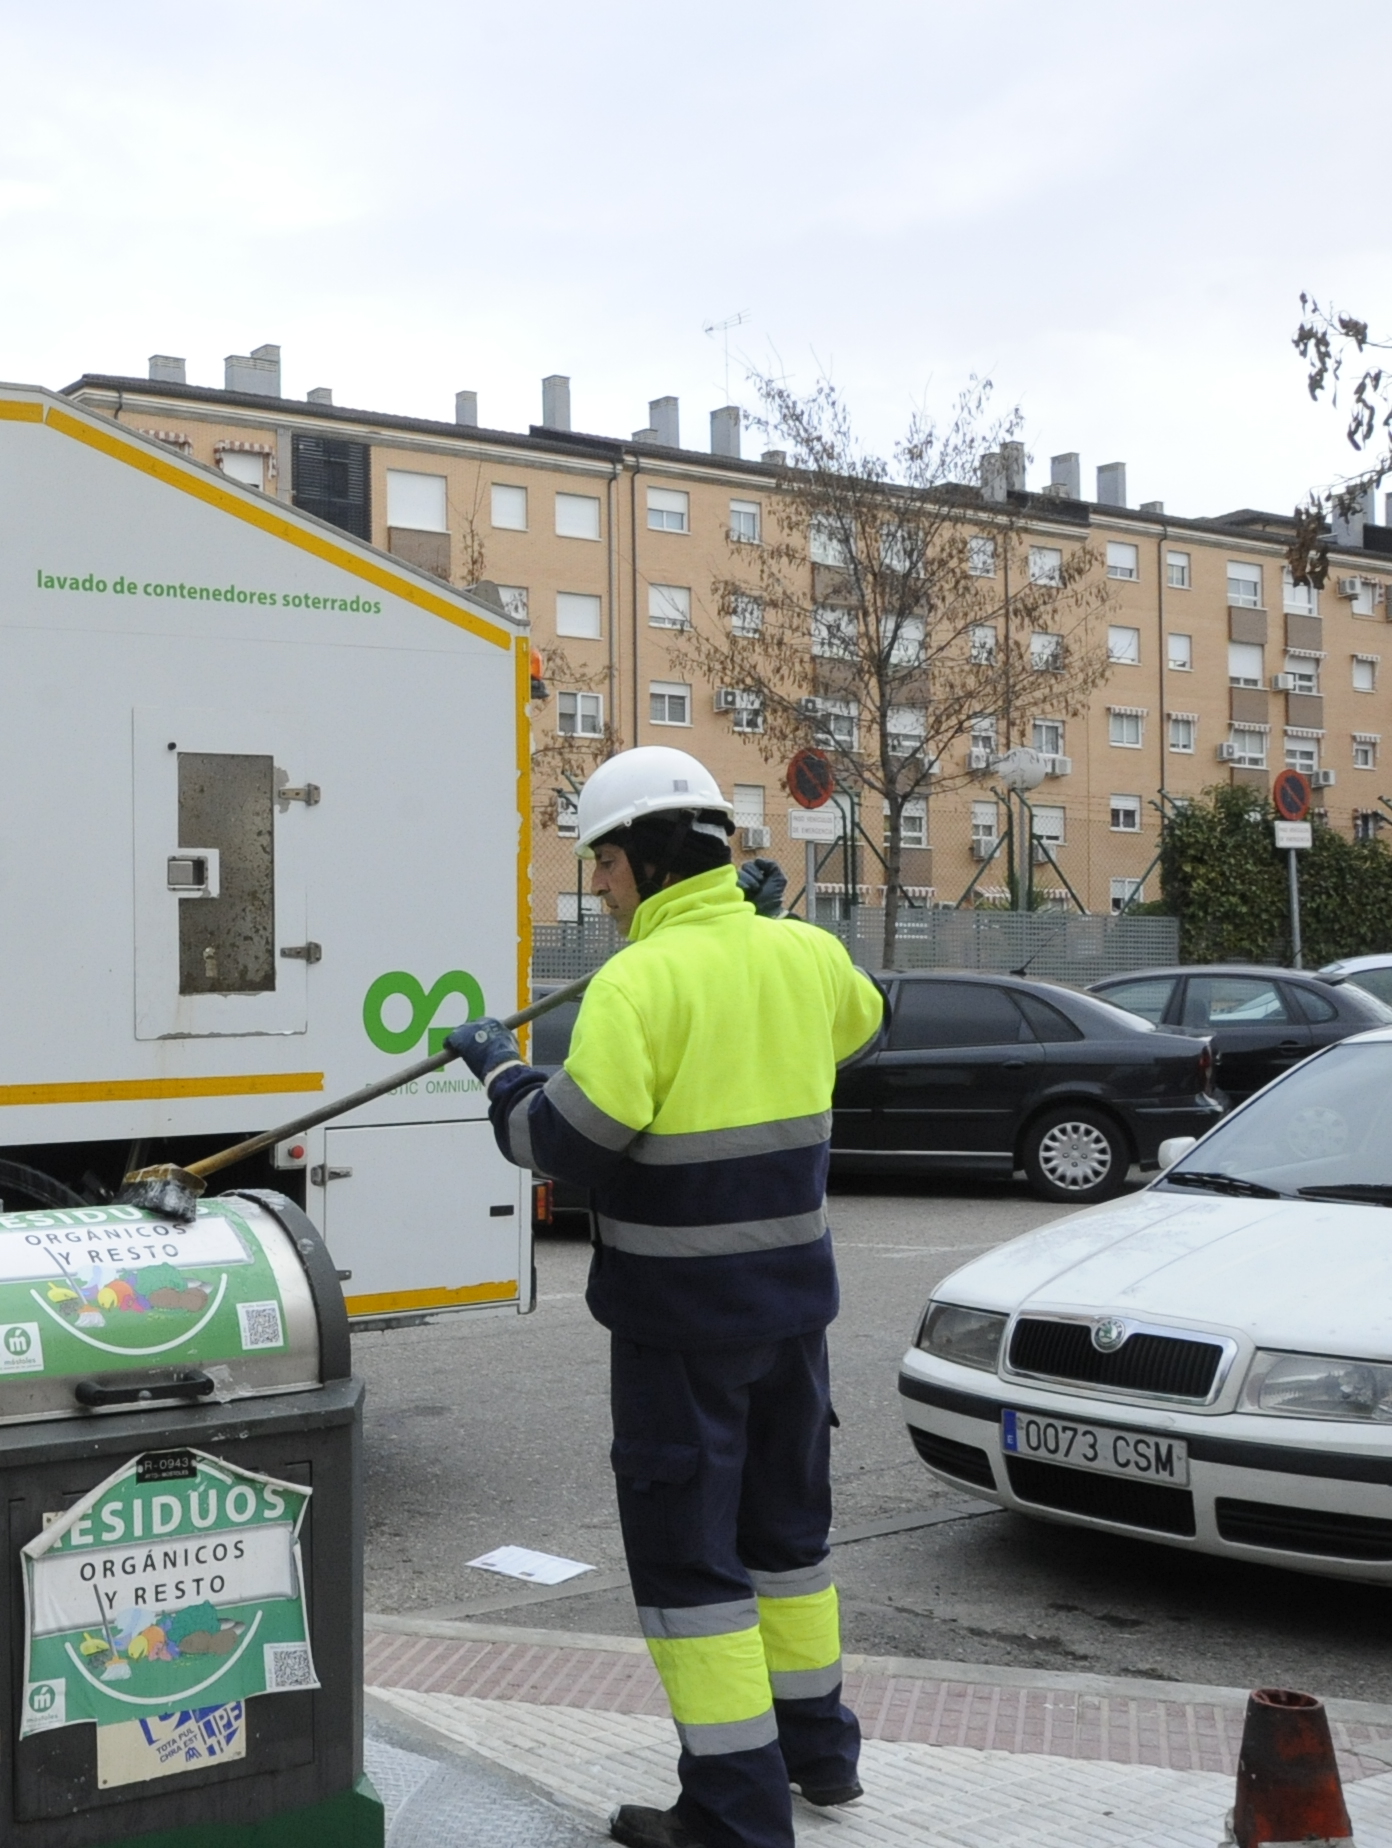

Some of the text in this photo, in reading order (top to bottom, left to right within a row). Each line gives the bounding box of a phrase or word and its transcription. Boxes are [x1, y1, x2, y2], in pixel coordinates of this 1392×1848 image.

[37, 569, 382, 614] lavado de contenedores soterrados
[425, 1079, 482, 1095] OMNIUM
[24, 1223, 188, 1246] ORGÁNICOS
[57, 1243, 180, 1266] Y RESTO
[1025, 1420, 1098, 1462] 0073
[1112, 1435, 1174, 1477] CSM
[80, 1540, 244, 1582] ORGÁNICOS
[104, 1575, 225, 1610] Y RESTO
[156, 1738, 177, 1755] TOTA
[183, 1733, 199, 1749] EST
